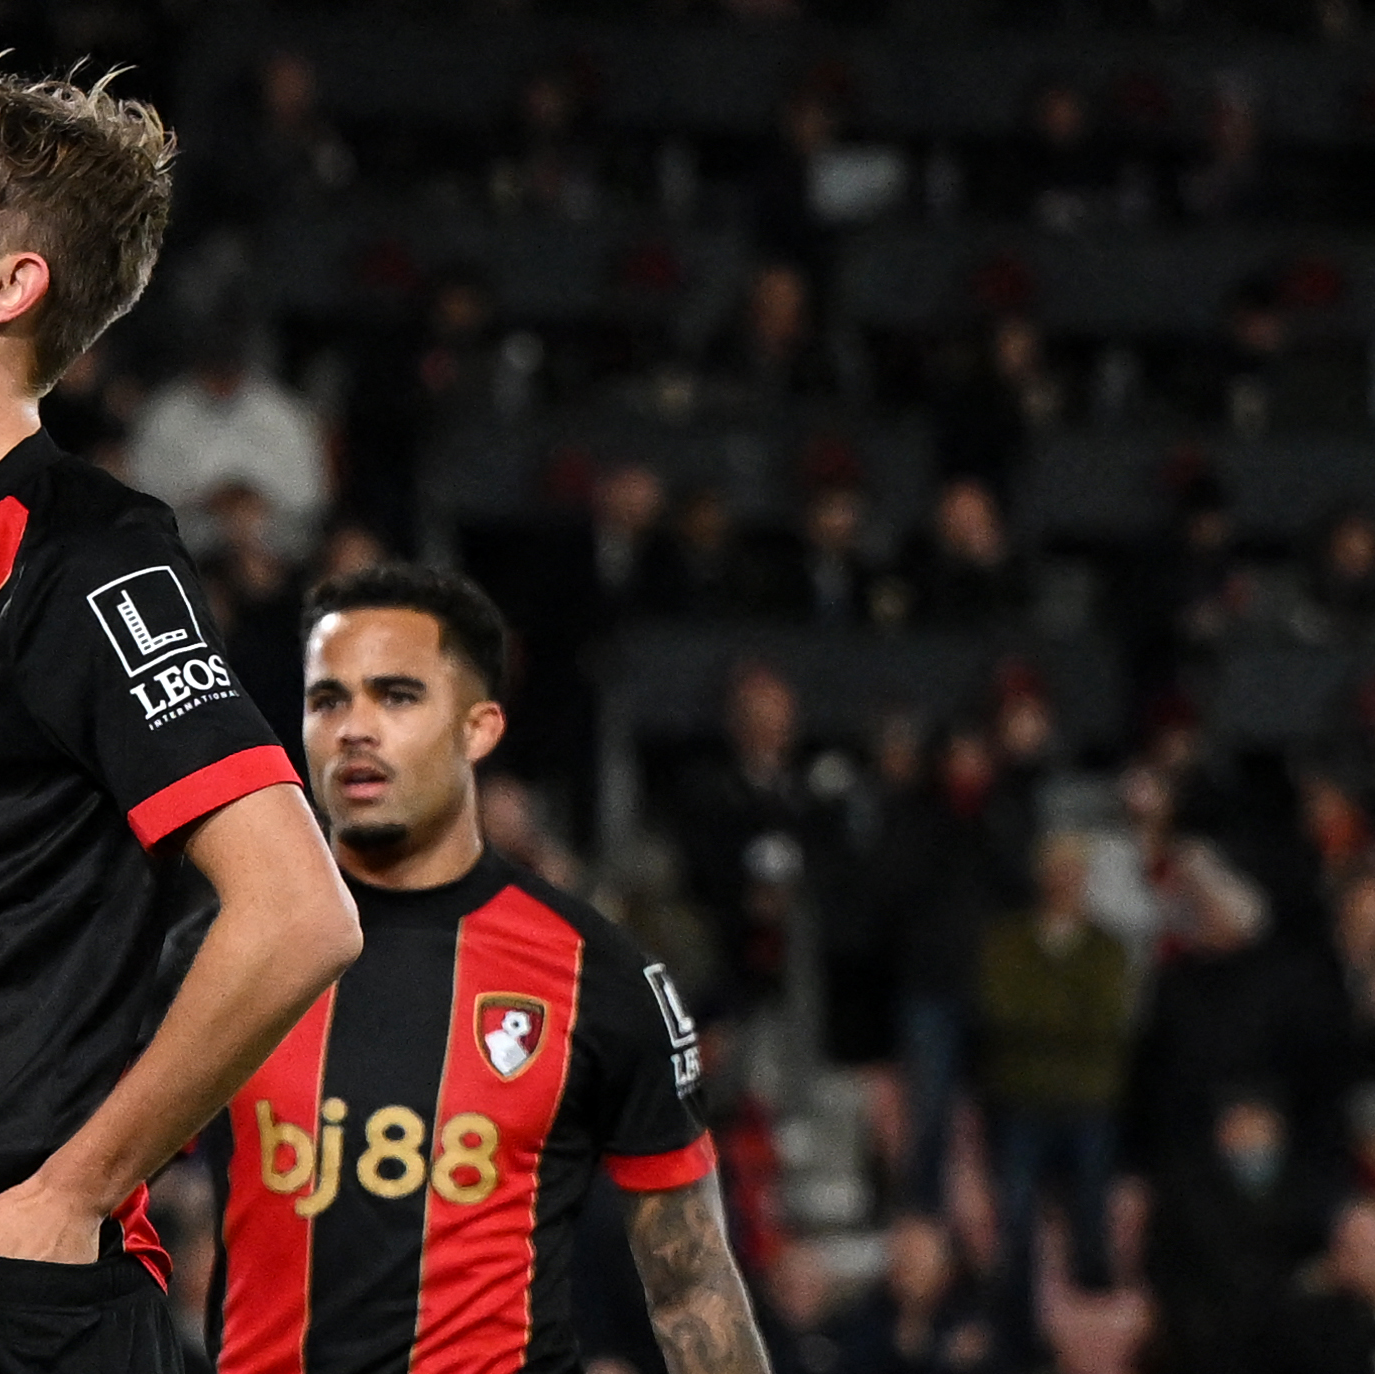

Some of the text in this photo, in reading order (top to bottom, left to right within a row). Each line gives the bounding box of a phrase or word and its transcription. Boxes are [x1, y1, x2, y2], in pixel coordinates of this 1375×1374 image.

[129, 654, 231, 720] LEOS
[149, 689, 240, 731] INTERNATIONAL
[255, 1097, 499, 1218] bj88
